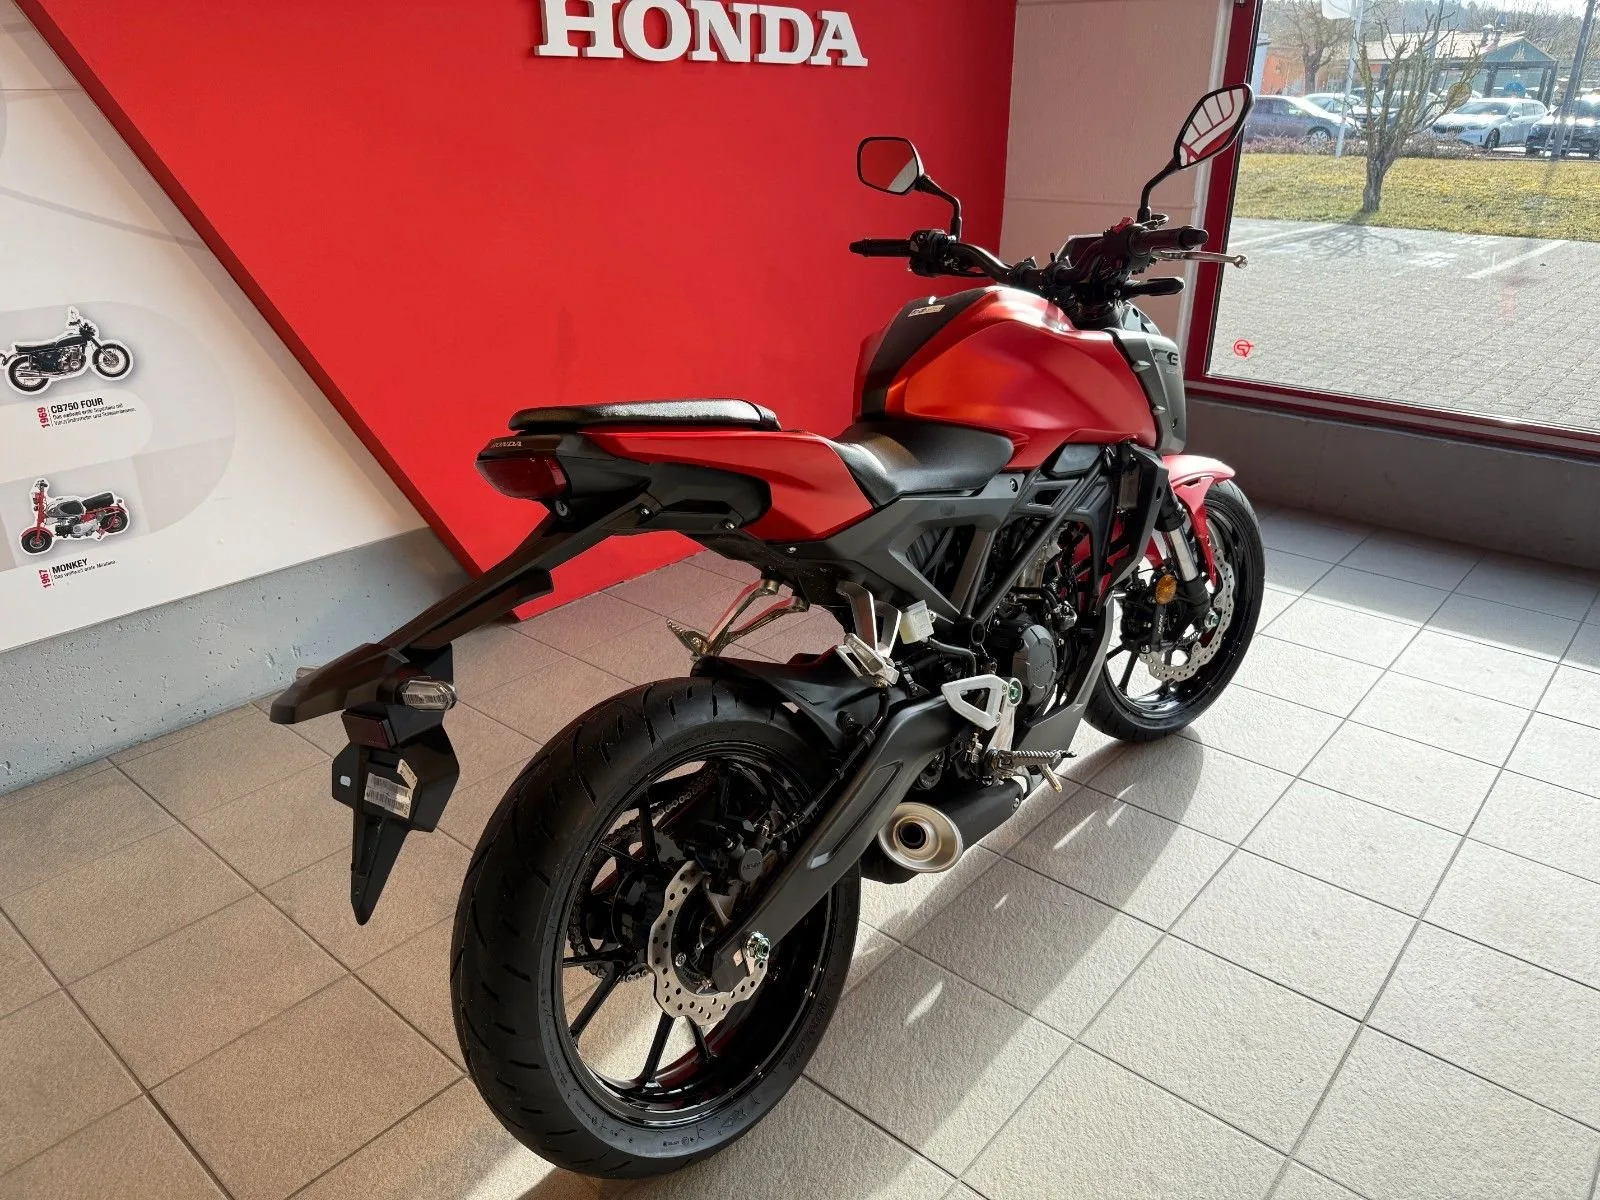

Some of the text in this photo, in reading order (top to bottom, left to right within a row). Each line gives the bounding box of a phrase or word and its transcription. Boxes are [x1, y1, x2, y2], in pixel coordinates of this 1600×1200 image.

[534, 0, 868, 67] HONDA
[50, 402, 79, 413] CB750
[80, 398, 104, 408] FOUR
[37, 407, 50, 428] 1969
[52, 558, 87, 574] MONKEY
[39, 569, 52, 588] 1967
